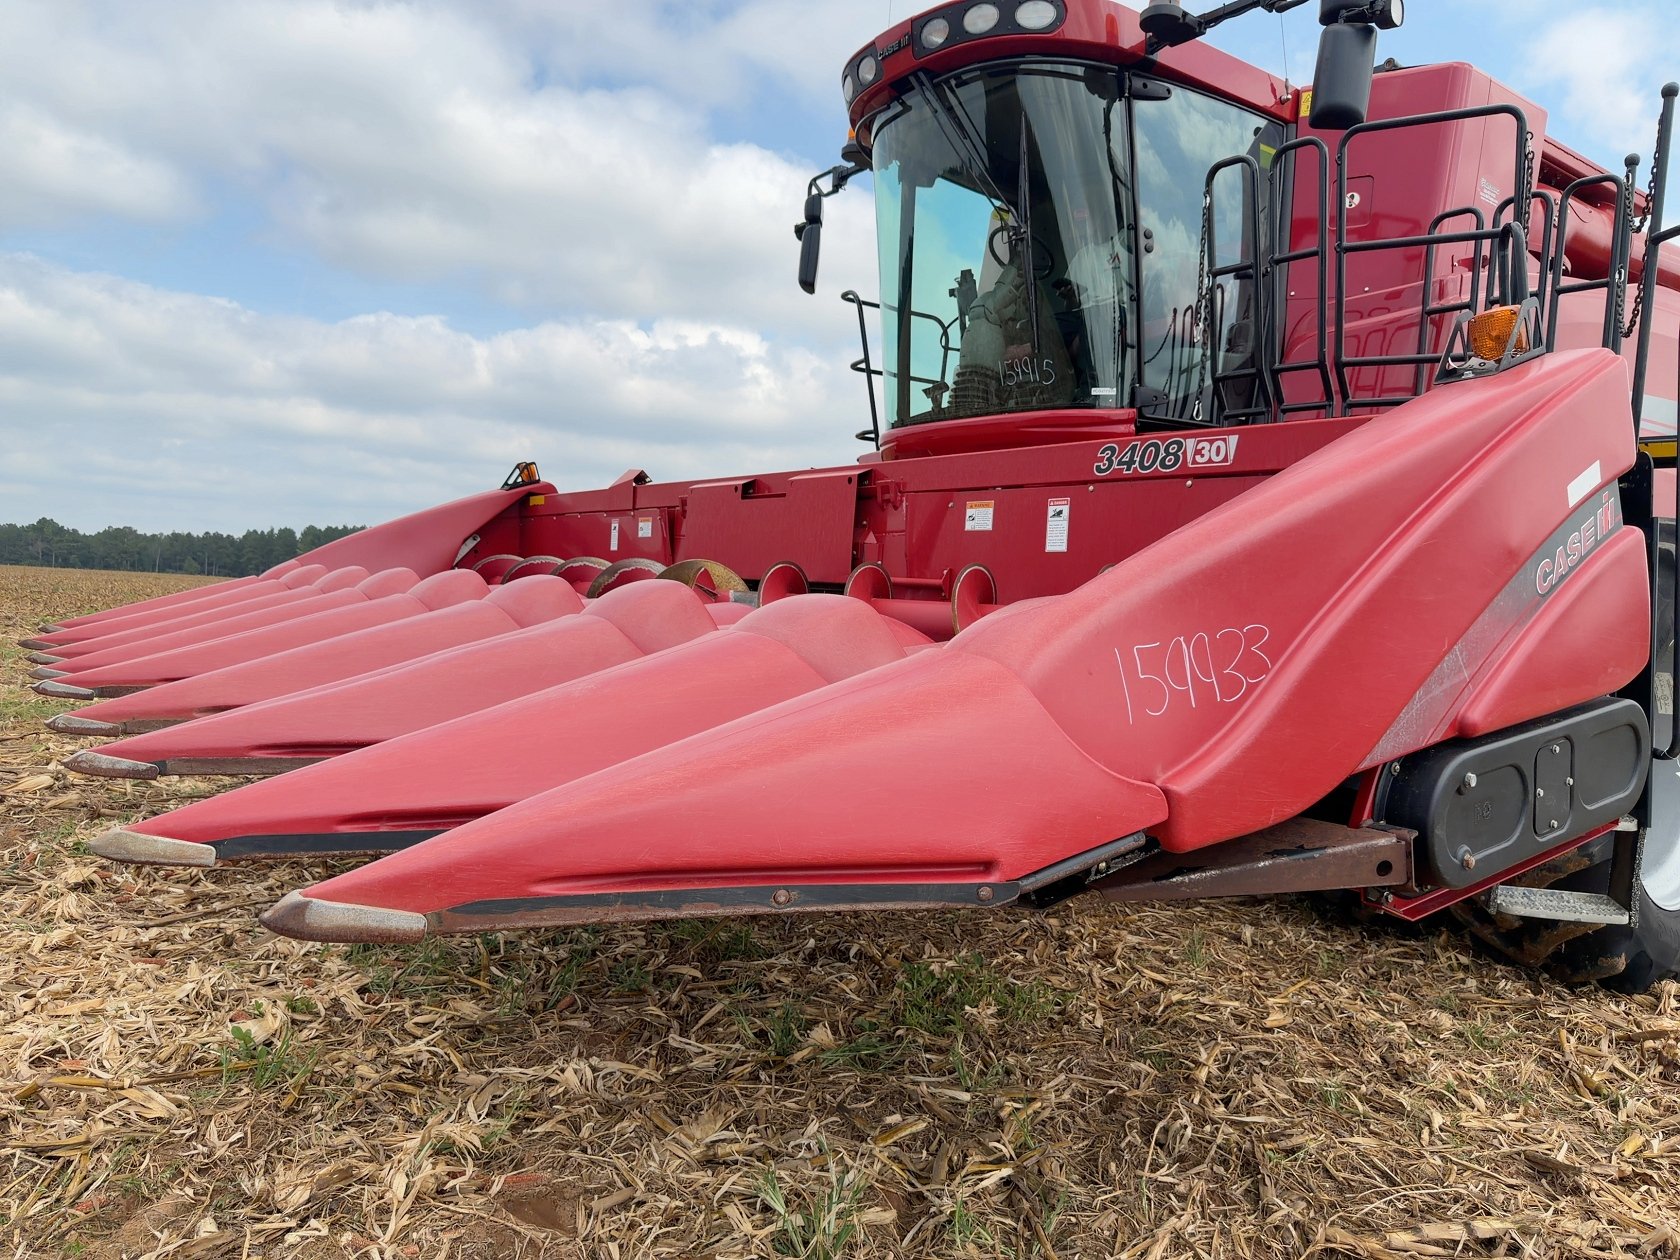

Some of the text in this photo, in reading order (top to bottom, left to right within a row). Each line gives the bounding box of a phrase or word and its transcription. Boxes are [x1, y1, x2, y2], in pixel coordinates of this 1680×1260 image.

[998, 356, 1055, 386] 159915
[1094, 437, 1226, 476] 3408 30
[1536, 516, 1596, 594] CASE
[1115, 624, 1271, 725] 159933
